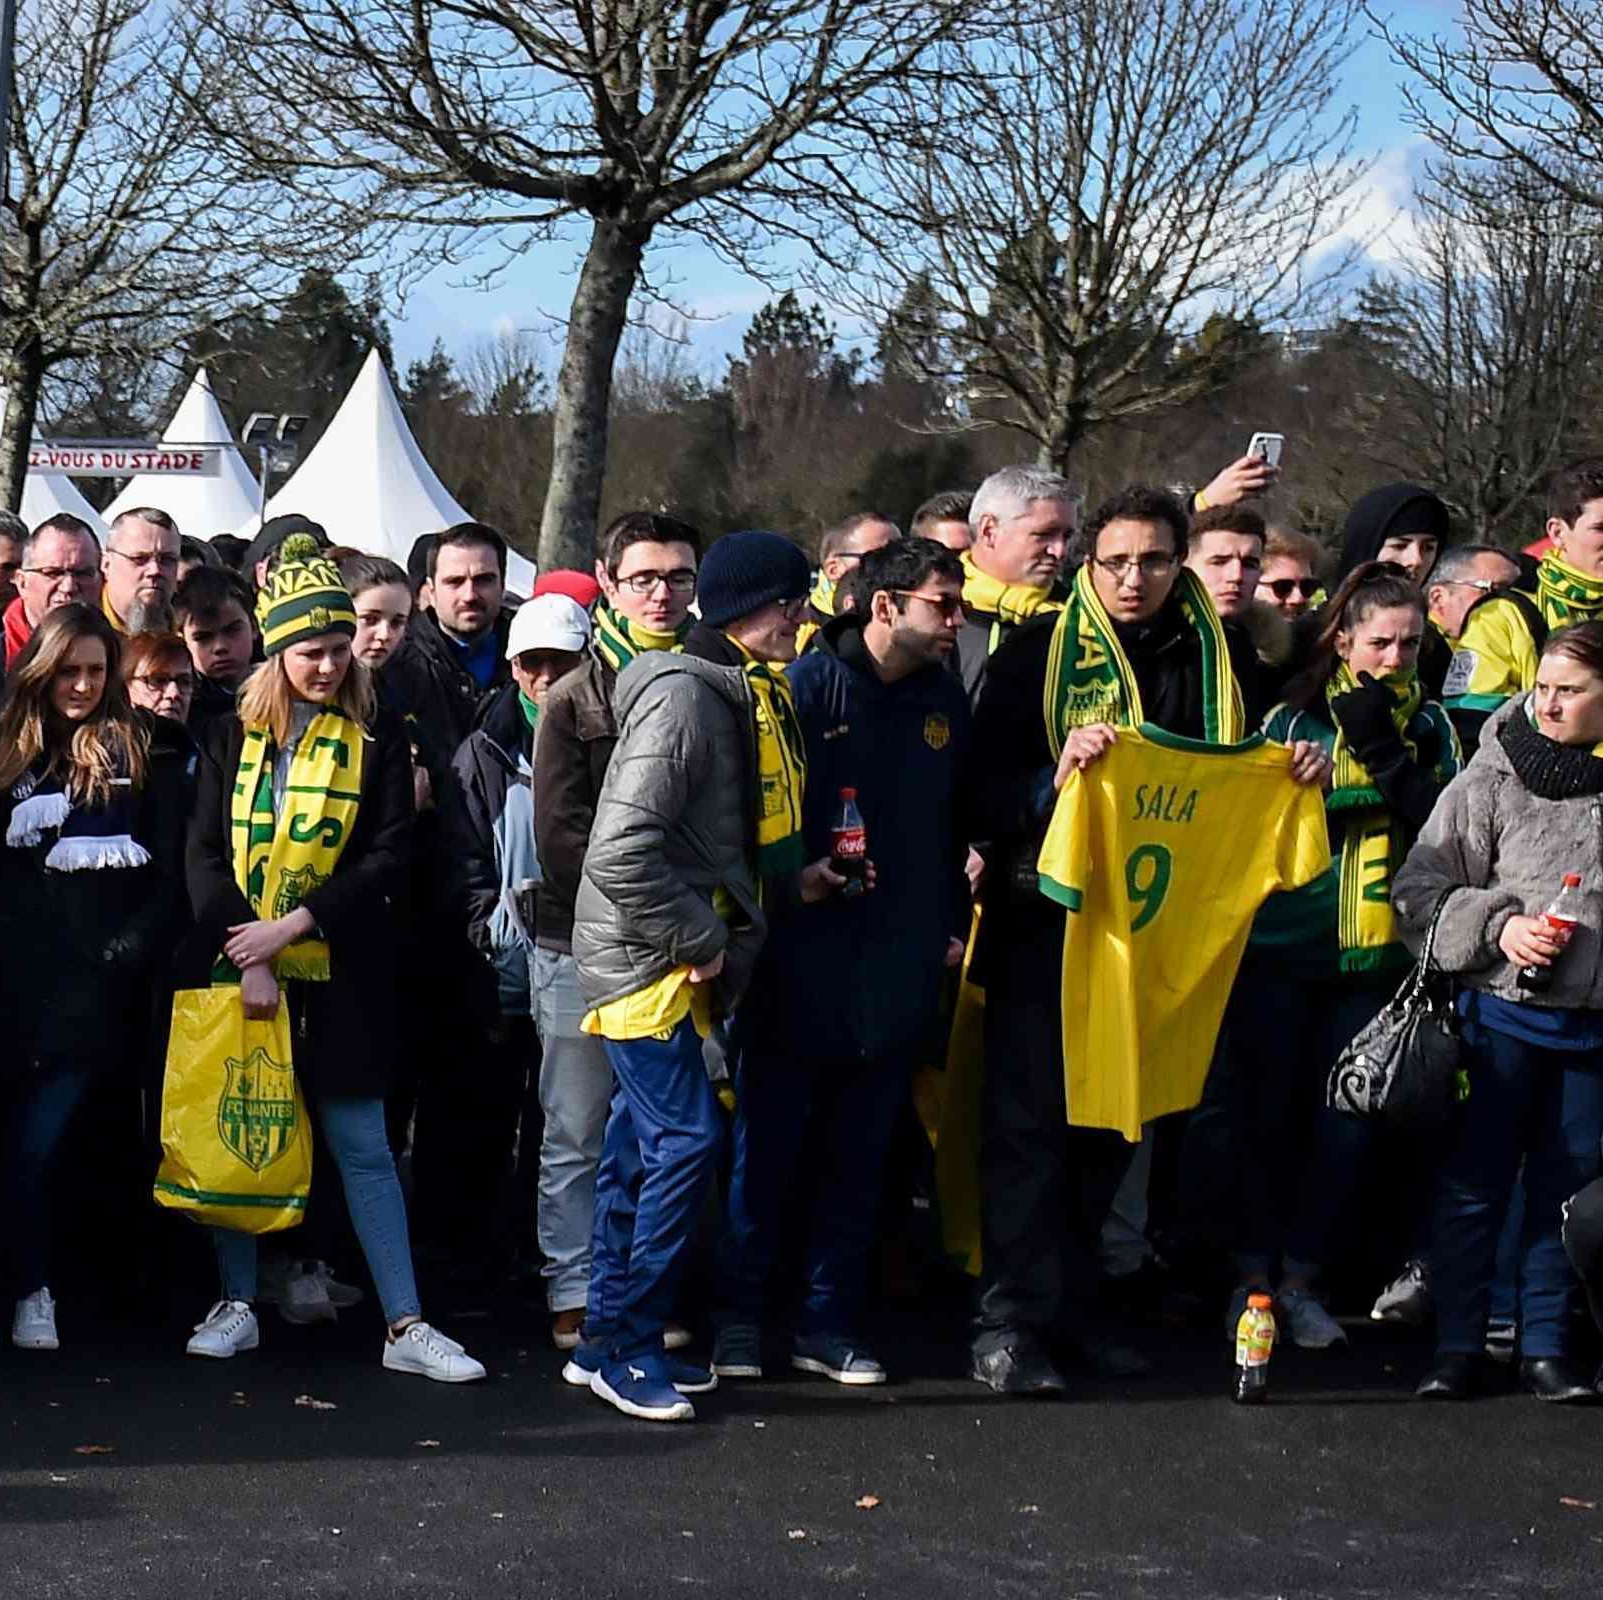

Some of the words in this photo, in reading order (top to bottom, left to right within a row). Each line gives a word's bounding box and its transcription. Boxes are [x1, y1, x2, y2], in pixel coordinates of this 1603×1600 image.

[102, 452, 127, 470] DU
[129, 451, 203, 471] STADE
[1131, 784, 1199, 824] SALA
[1124, 843, 1173, 934] 9
